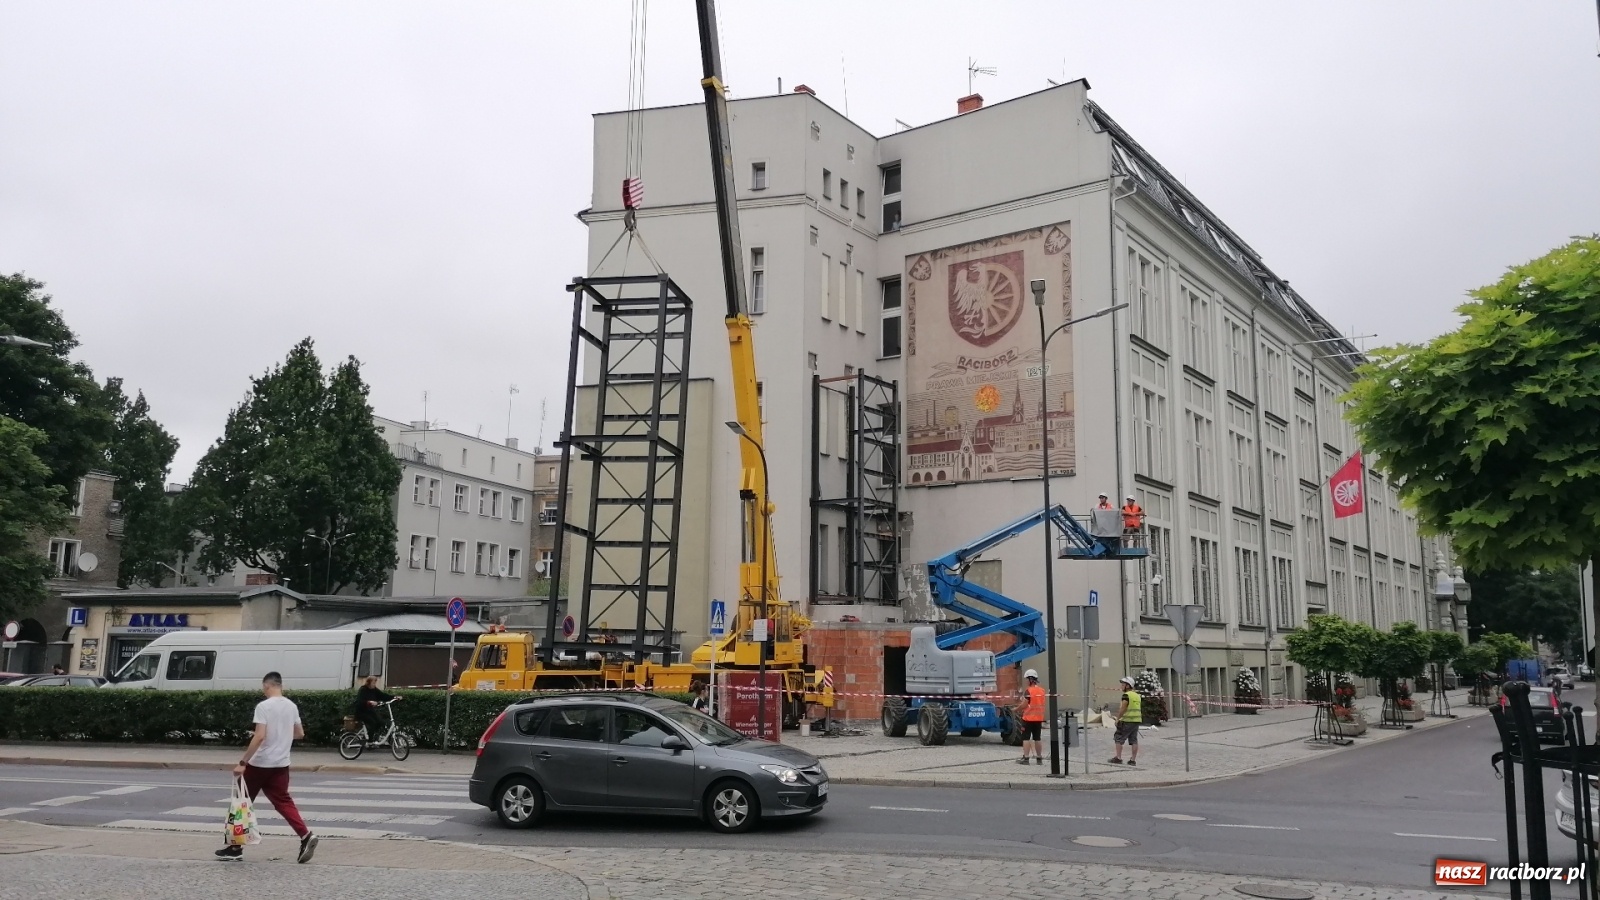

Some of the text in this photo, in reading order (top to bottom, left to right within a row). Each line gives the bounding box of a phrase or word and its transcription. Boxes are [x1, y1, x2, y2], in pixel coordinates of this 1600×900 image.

[925, 378, 964, 390] PRAWA
[966, 370, 1018, 384] MIEJSKIE
[74, 610, 83, 623] L
[129, 613, 189, 627] ATLAS
